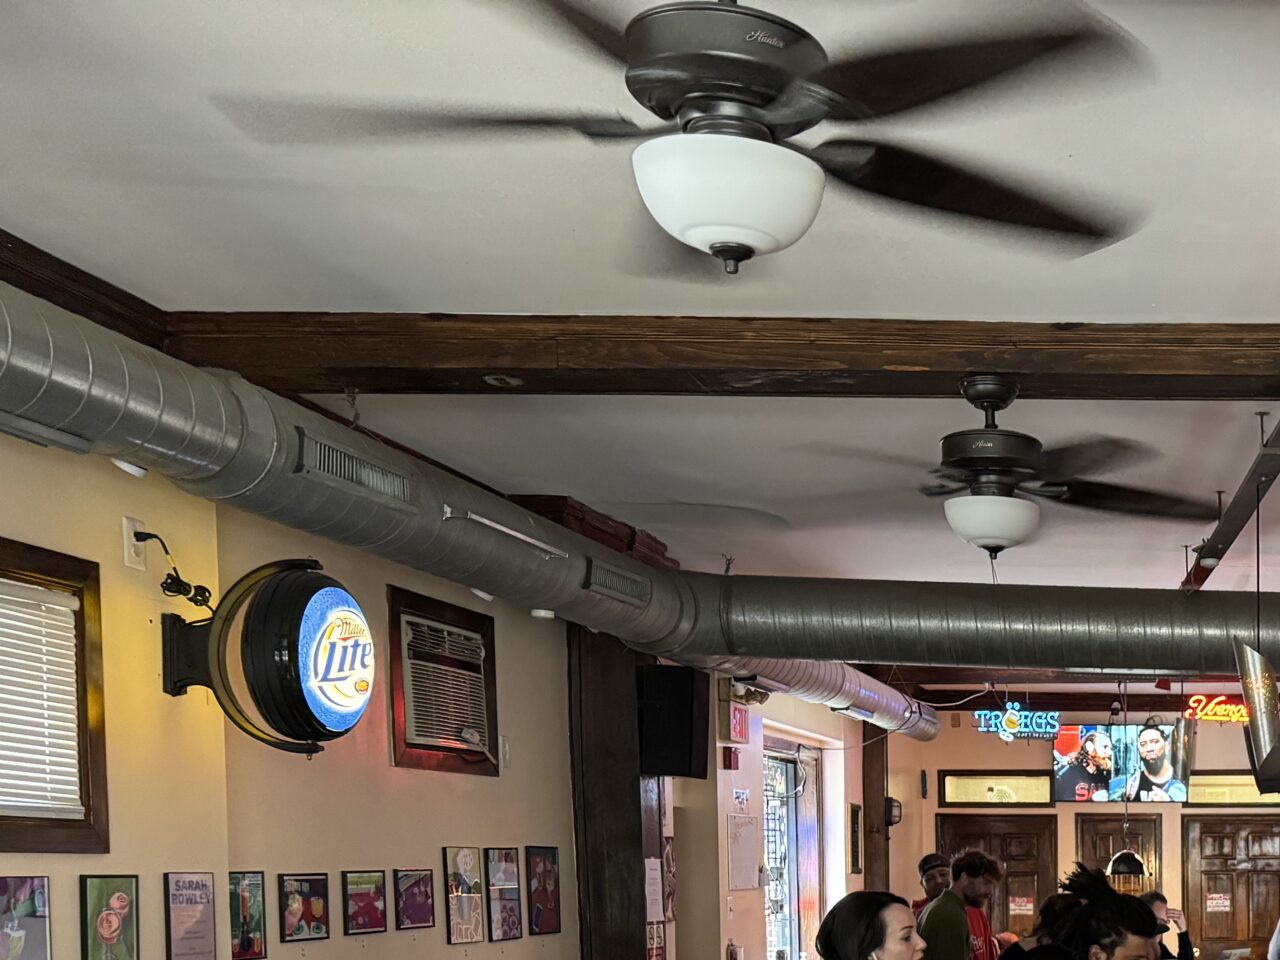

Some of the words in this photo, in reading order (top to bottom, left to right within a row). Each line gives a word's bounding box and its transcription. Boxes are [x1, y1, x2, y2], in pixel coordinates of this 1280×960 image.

[335, 618, 366, 636] Miller
[317, 639, 372, 682] Lite
[175, 880, 207, 892] SARAH
[171, 893, 211, 905] ROWLEY
